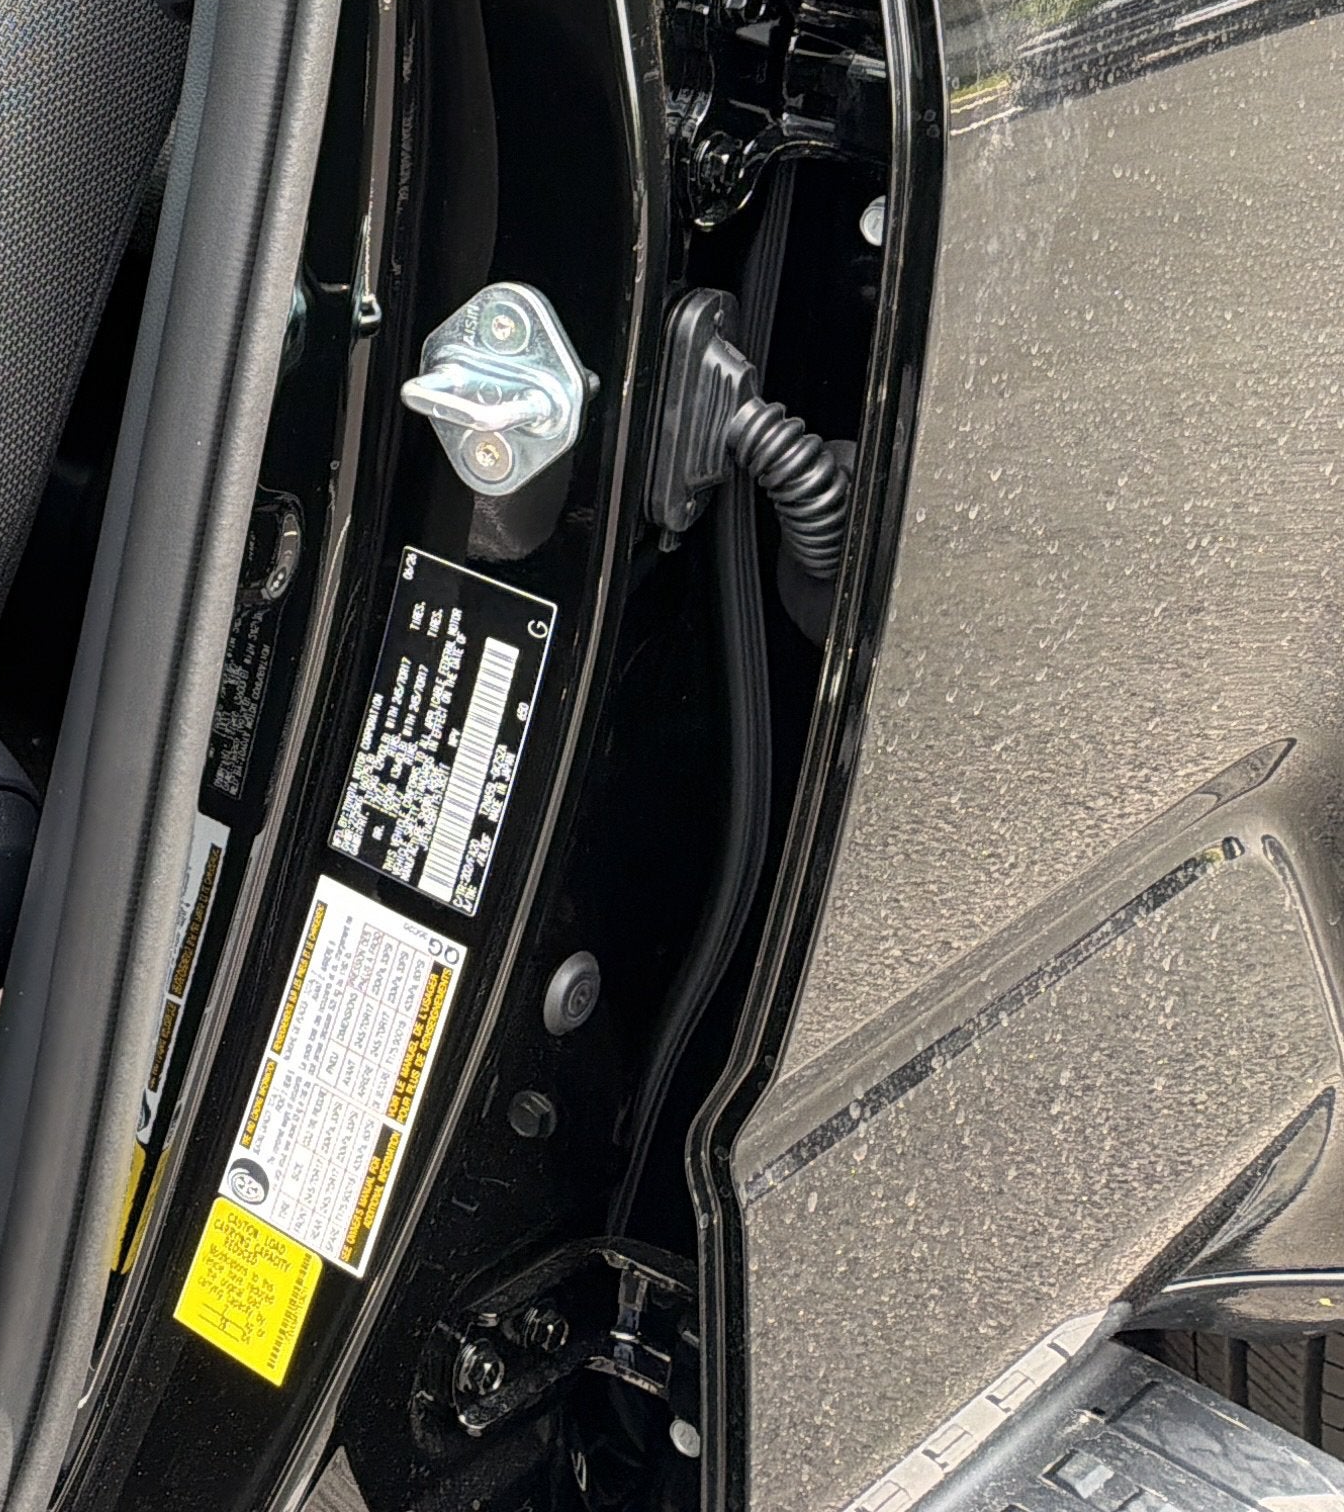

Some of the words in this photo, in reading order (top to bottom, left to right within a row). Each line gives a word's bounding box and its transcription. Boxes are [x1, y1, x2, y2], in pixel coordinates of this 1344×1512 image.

[463, 304, 480, 347] AISIN
[408, 598, 427, 632] TIRES.
[426, 605, 444, 639] TIRES.
[445, 606, 463, 637] MOTOR
[525, 616, 550, 641] G
[436, 636, 456, 676] FEDERAL
[448, 644, 465, 671] DATE
[390, 655, 413, 705] 245/70R17
[407, 662, 430, 713] 245/70R17
[444, 670, 458, 689] THE
[423, 675, 446, 730] APPLICABLE
[439, 689, 453, 705] ON
[384, 704, 399, 730] WITH
[401, 711, 417, 738] WITH
[430, 705, 449, 740] EFFECT
[350, 749, 366, 781] MOTOR
[359, 691, 384, 752] CORPORATION
[418, 730, 432, 750] ALL
[487, 797, 503, 823] MADE
[498, 750, 516, 782] JAPAN
[389, 809, 408, 849] VEHICLE
[382, 847, 397, 873] THIS
[390, 837, 409, 878] VEHICLE
[399, 822, 424, 883] MANUFACTURE
[416, 971, 439, 1021] L'USAGER
[417, 965, 453, 1052] RENSEIGNEMENTS
[412, 1020, 424, 1037] DE
[399, 1036, 419, 1078] MANUEL
[413, 1051, 425, 1068] DE
[394, 1078, 406, 1094] LE
[404, 1067, 421, 1095] PLUS
[386, 1093, 401, 1119] VOIR
[395, 1094, 412, 1124] POUR
[361, 1182, 384, 1230] ADDITIONAL
[376, 1129, 401, 1184] INFORMATION
[339, 1243, 352, 1262] SEE
[357, 1173, 375, 1208] MANUAL
[368, 1154, 381, 1175] FOR
